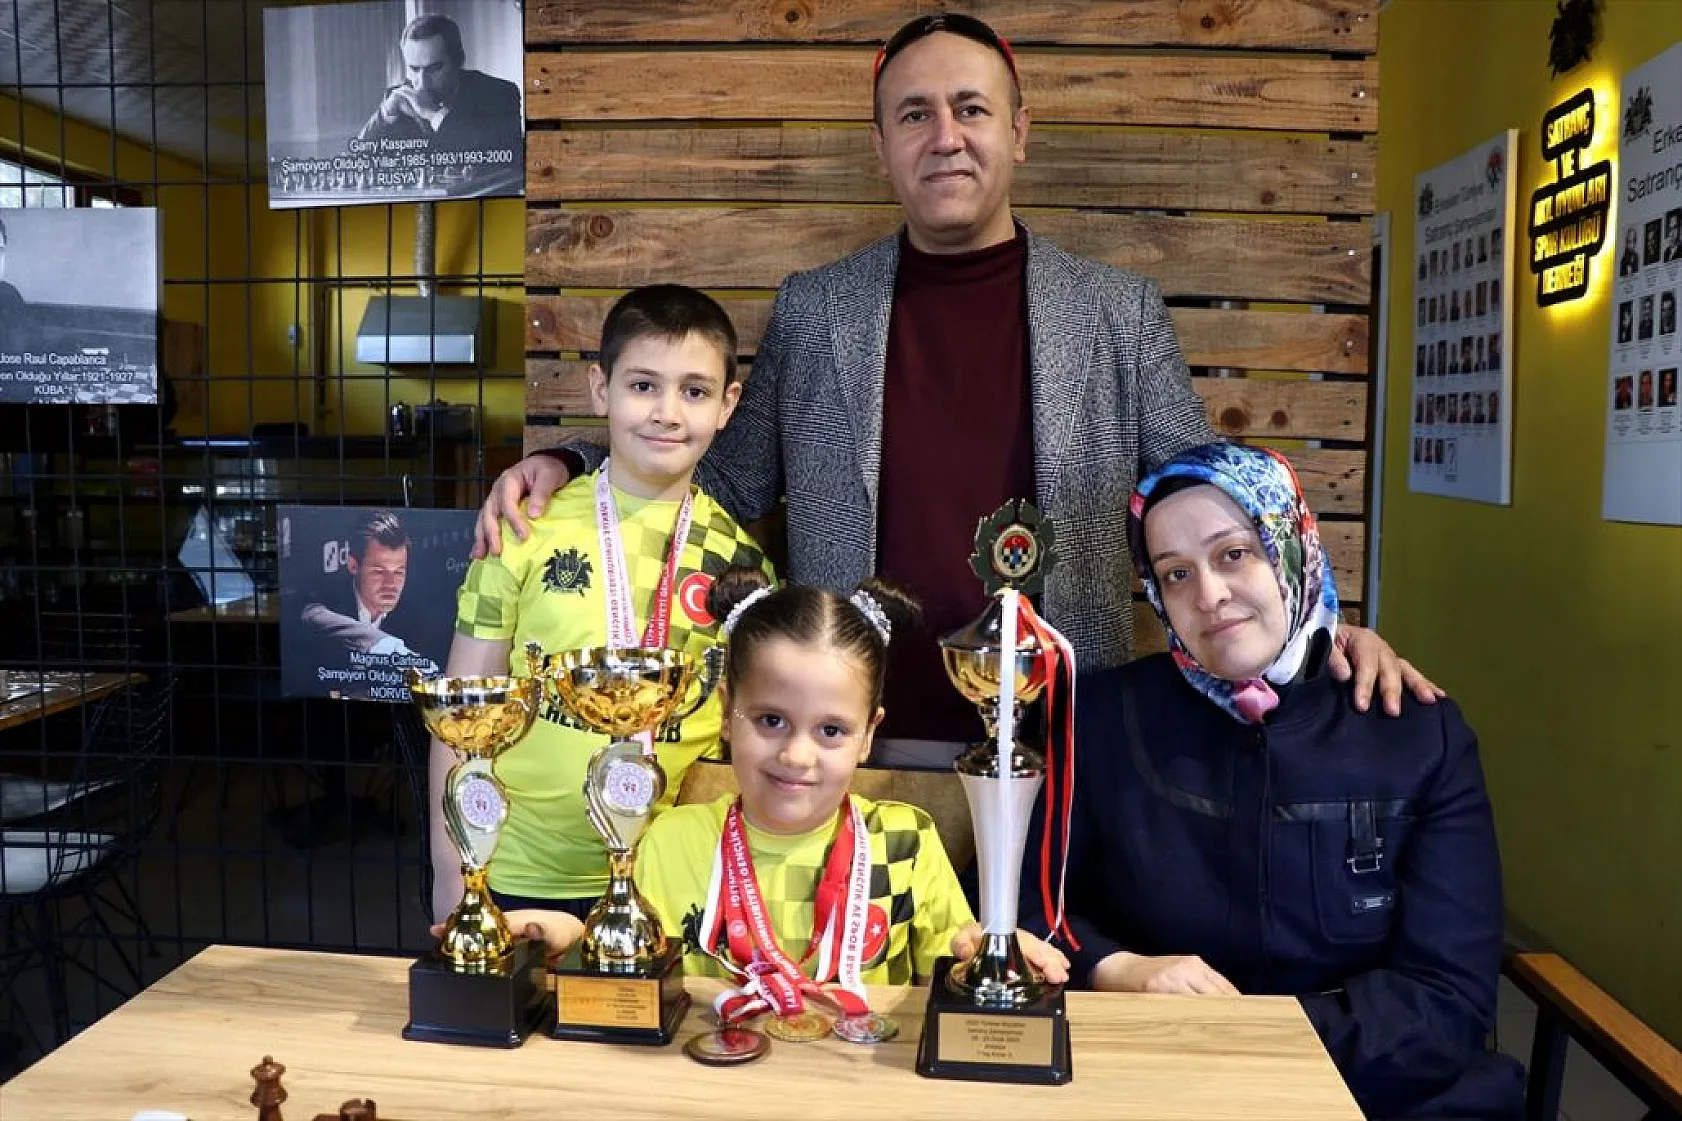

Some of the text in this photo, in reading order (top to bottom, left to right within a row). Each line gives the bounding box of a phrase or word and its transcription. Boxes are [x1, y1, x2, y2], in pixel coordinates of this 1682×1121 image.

[350, 138, 429, 153] Garry Kasparov
[377, 172, 416, 184] RUSYA
[49, 352, 106, 367] Capablanca
[350, 652, 429, 668] Magnus Carlsen
[318, 666, 366, 684] Şampiyon
[370, 685, 412, 700] NORVE
